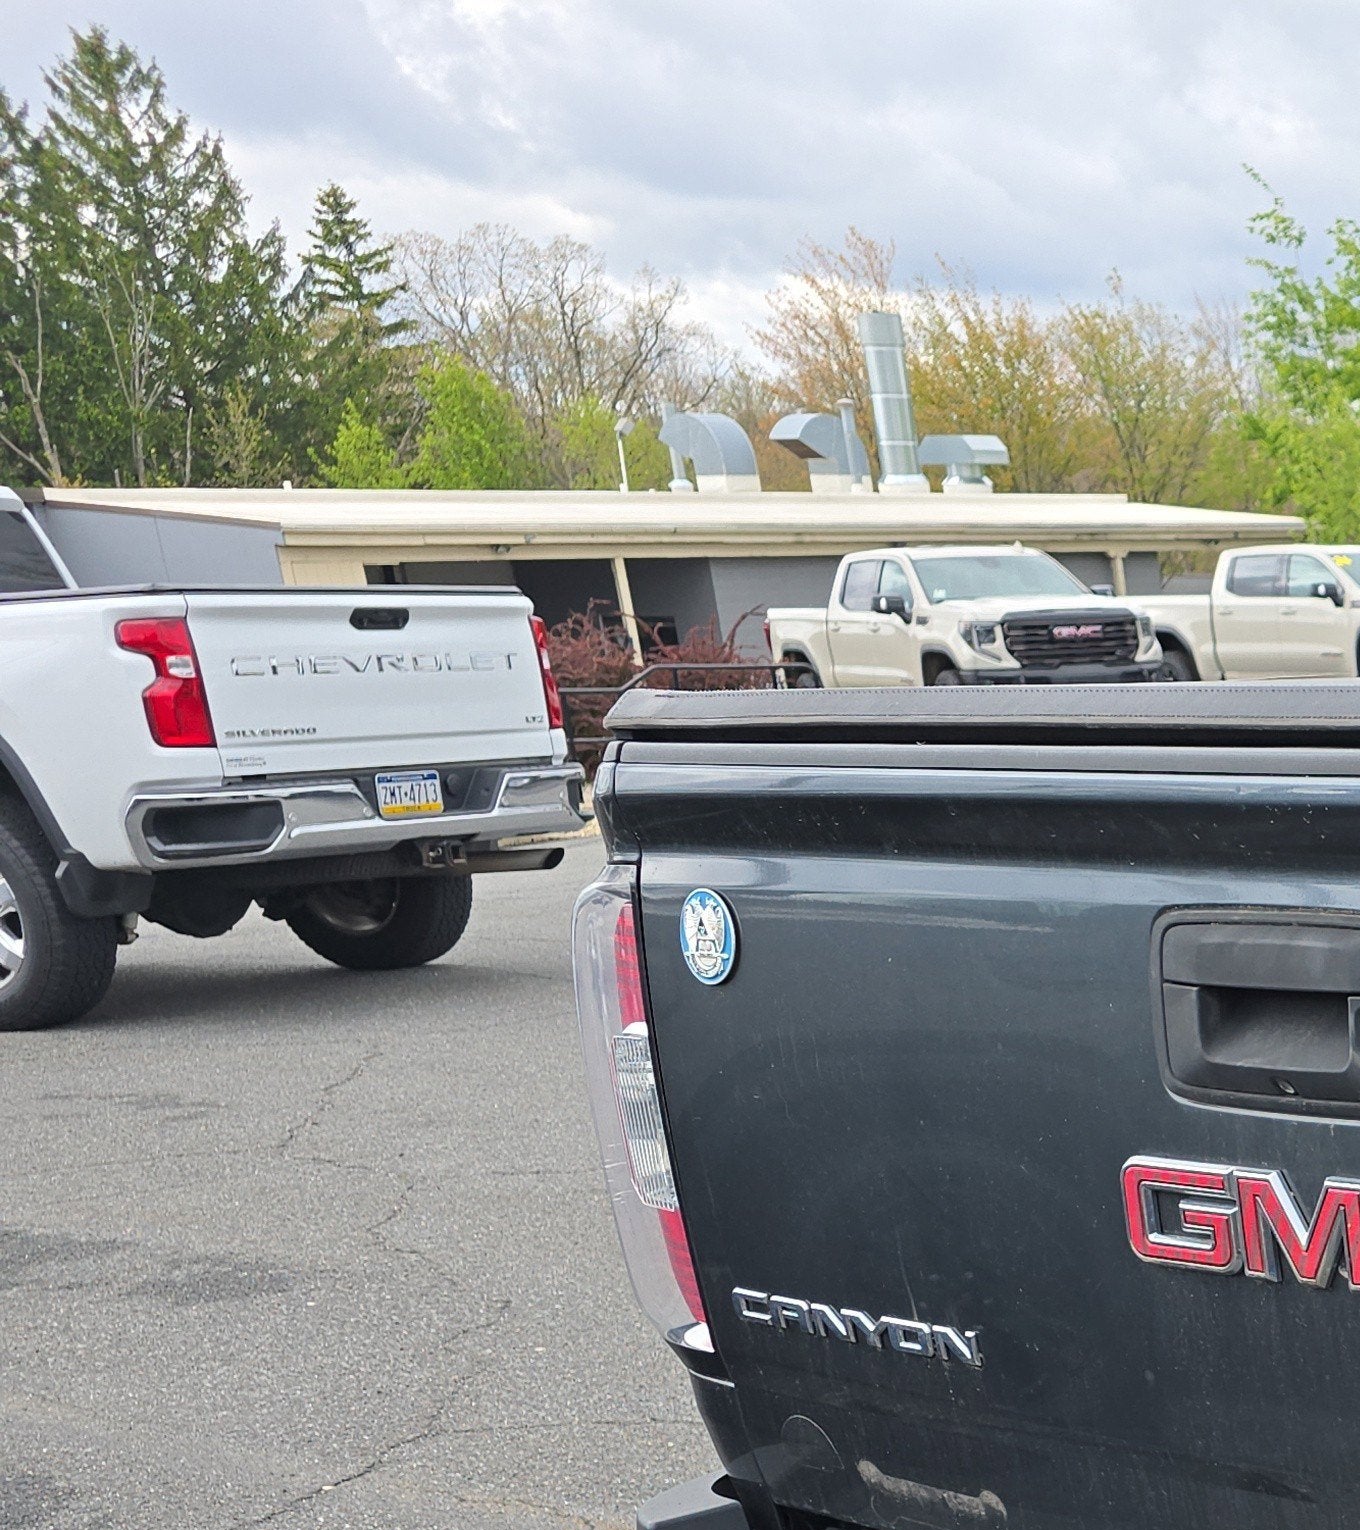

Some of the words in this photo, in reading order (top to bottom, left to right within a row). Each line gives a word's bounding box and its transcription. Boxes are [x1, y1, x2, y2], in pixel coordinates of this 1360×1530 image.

[230, 651, 518, 677] CHEVROLET
[223, 726, 318, 739] SILVERADO
[730, 1286, 984, 1368] CANYON
